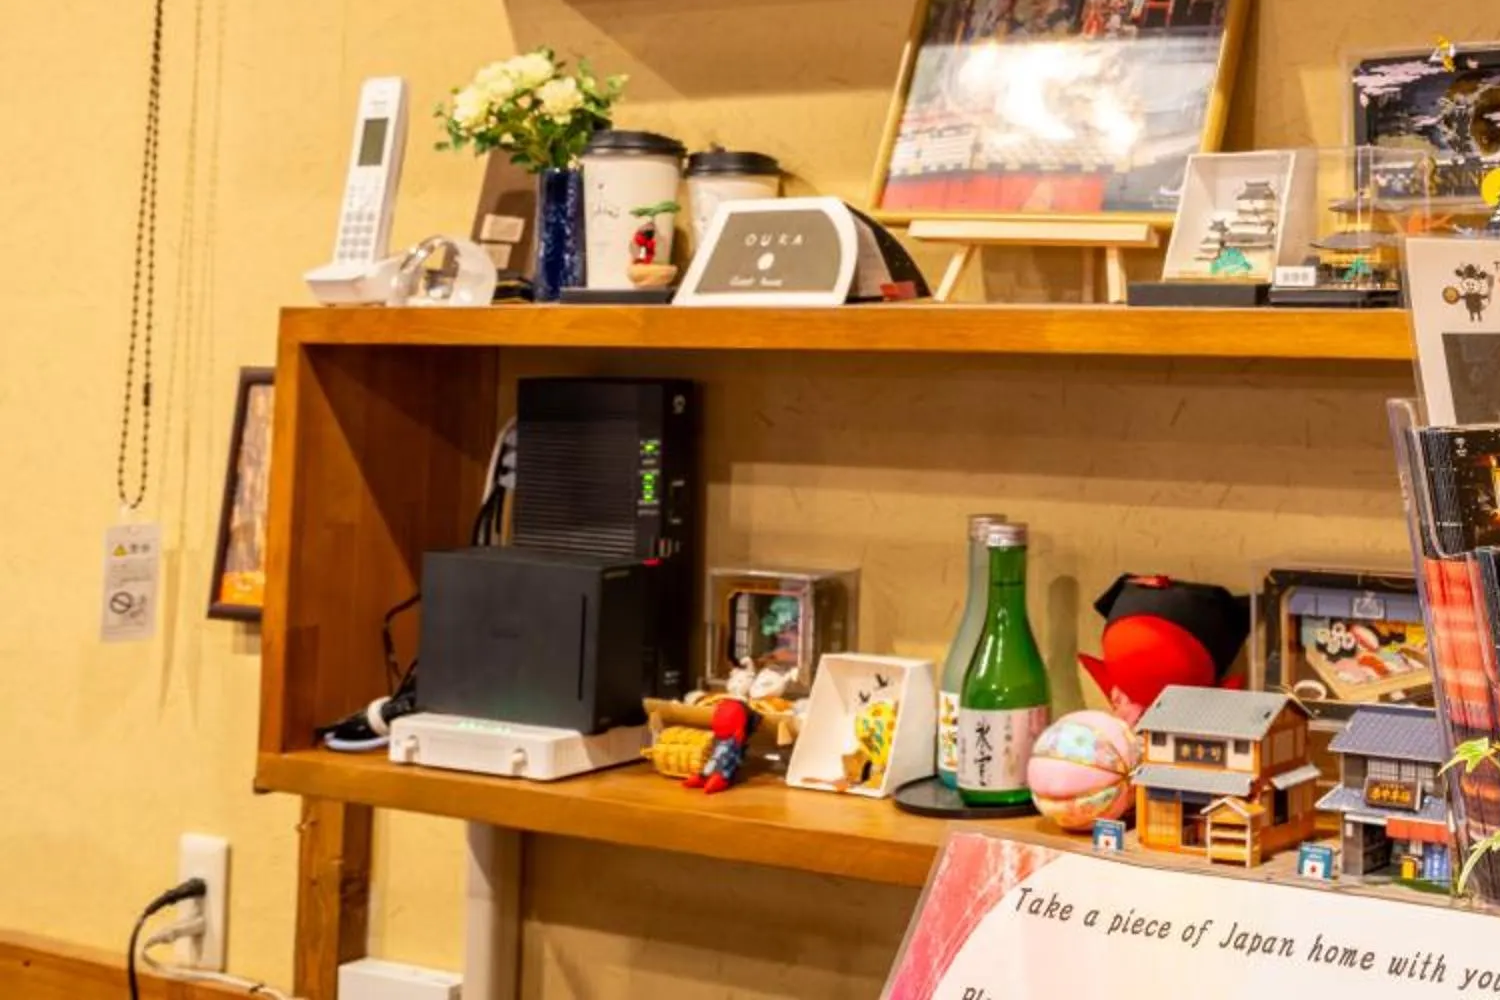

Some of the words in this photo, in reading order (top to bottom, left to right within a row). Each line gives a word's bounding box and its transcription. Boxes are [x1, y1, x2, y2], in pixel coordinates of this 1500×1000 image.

[1014, 887, 1075, 922] Take
[1083, 908, 1101, 928] a
[1107, 908, 1173, 936] piece
[1180, 918, 1214, 949] of
[1218, 921, 1296, 957] Japan
[1306, 933, 1376, 971] home
[1387, 950, 1448, 984] with
